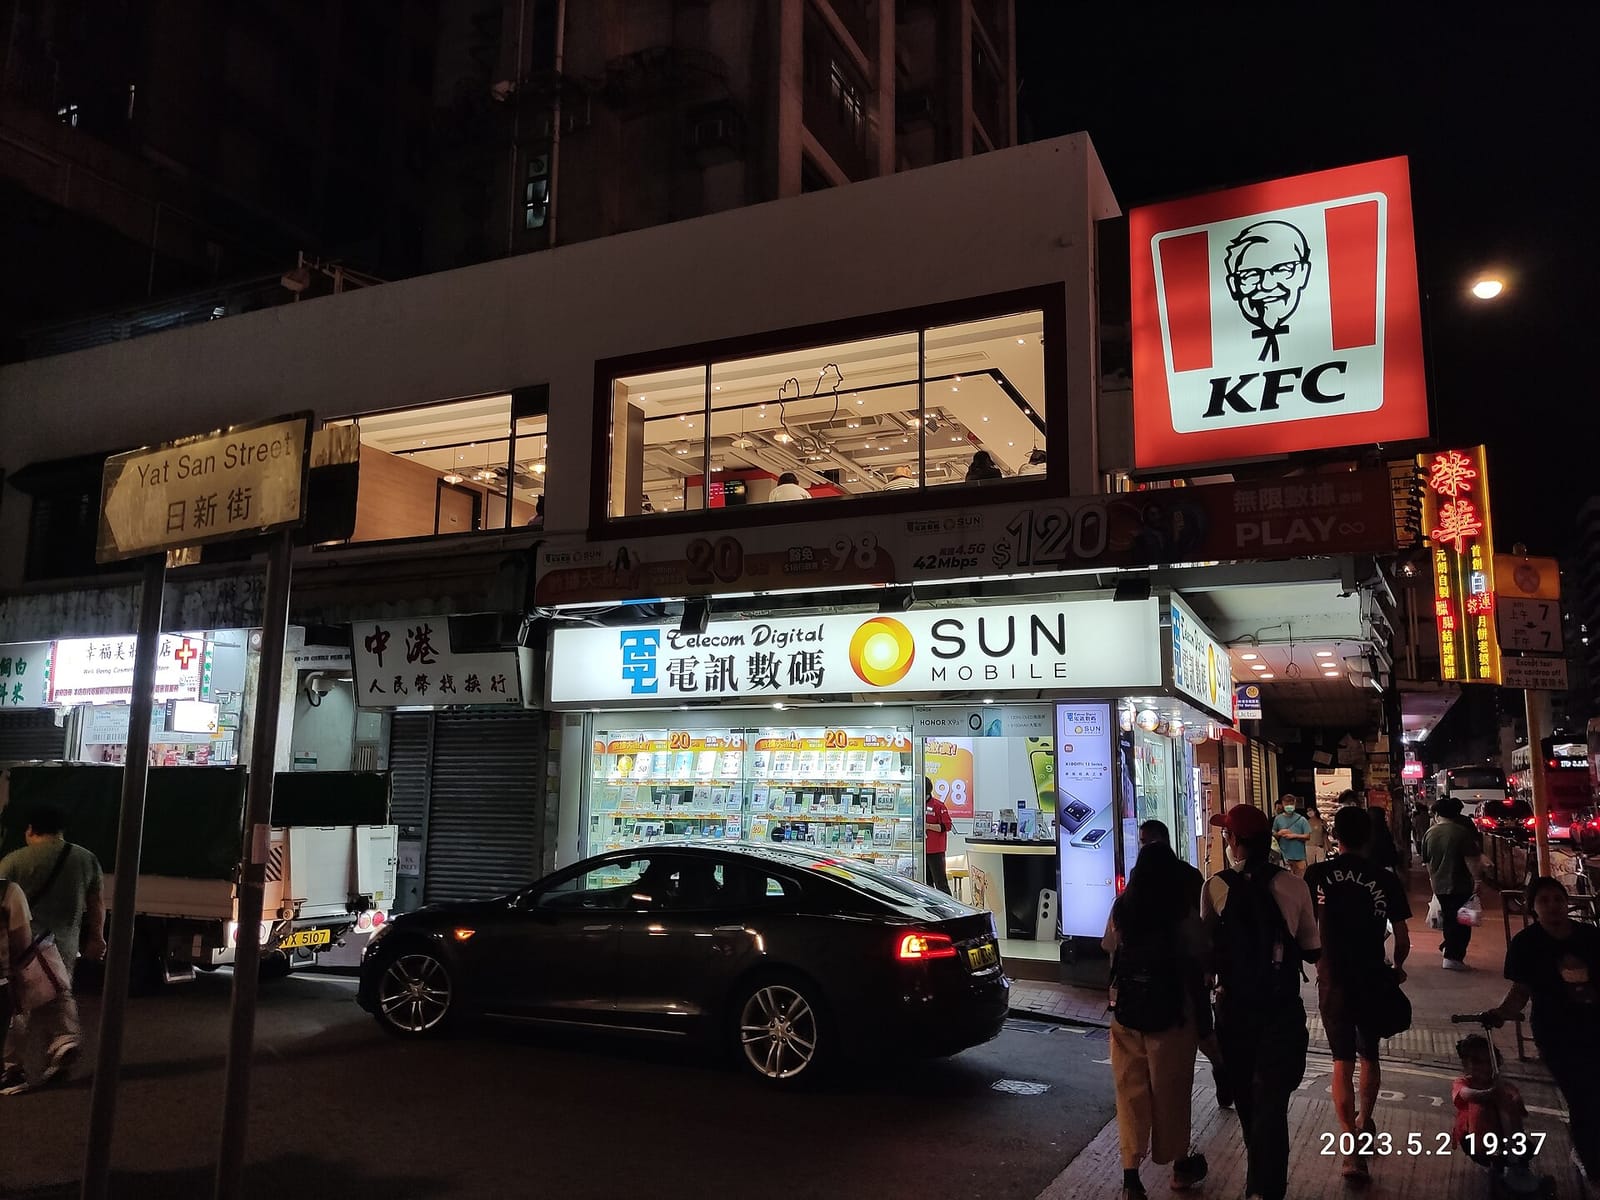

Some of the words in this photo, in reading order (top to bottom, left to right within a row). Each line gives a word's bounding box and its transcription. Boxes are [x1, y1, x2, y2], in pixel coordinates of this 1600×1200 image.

[1202, 361, 1348, 418] KFC
[138, 460, 170, 488] Yat
[177, 455, 216, 479] San
[224, 432, 292, 470] Street
[166, 488, 253, 534] 日新街
[1431, 452, 1482, 553] 榮華
[992, 503, 1110, 569] $120
[1235, 516, 1337, 548] PLAY
[913, 555, 978, 570] 42Mbps
[1538, 604, 1549, 620] 7
[364, 623, 439, 668] 中港
[667, 628, 746, 650] Telecom
[751, 624, 825, 648] Digital
[930, 613, 1066, 660] SUN
[1541, 631, 1551, 648] 7
[369, 673, 507, 696] 人民幣找換行
[665, 649, 825, 693] 電訊數碼
[931, 662, 1067, 682] MOBILE
[670, 731, 691, 750] 20
[824, 730, 848, 749] 20
[934, 779, 967, 805] 98
[1333, 870, 1387, 918] BALANCE
[302, 932, 326, 944] 5107
